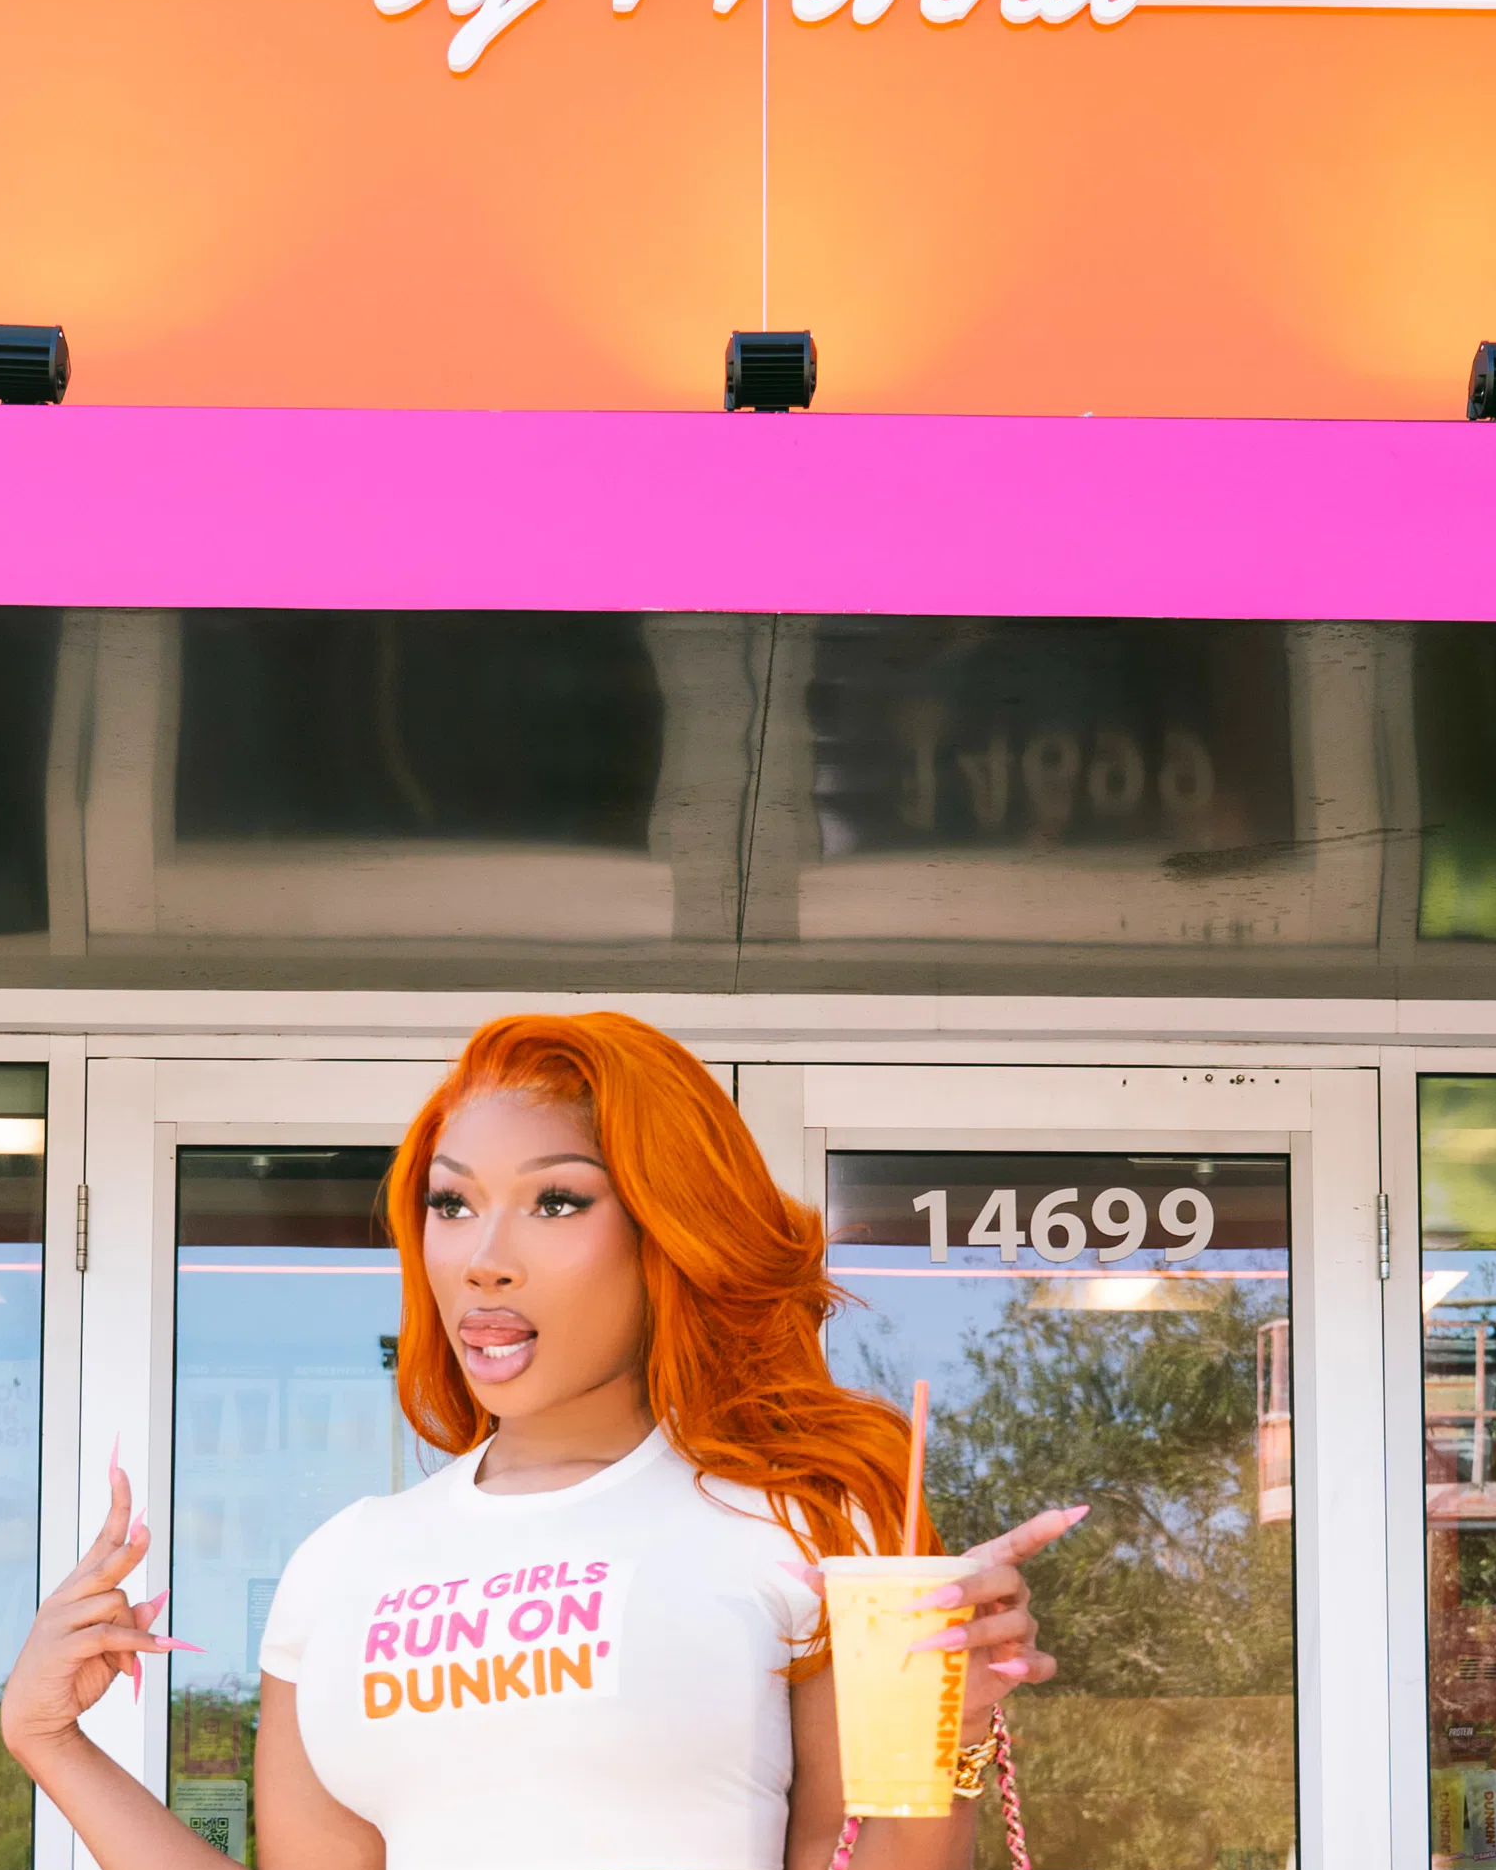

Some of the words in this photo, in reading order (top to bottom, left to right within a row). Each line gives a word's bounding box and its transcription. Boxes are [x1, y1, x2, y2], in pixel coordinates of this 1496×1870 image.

[912, 1187, 1215, 1263] 14699
[374, 1578, 469, 1616] HOT
[482, 1562, 610, 1599] GIRLS
[364, 1608, 489, 1663] RUN
[507, 1591, 602, 1642] ON
[363, 1640, 611, 1719] DUNKIN'
[1484, 1791, 1496, 1847] DUNKIN'
